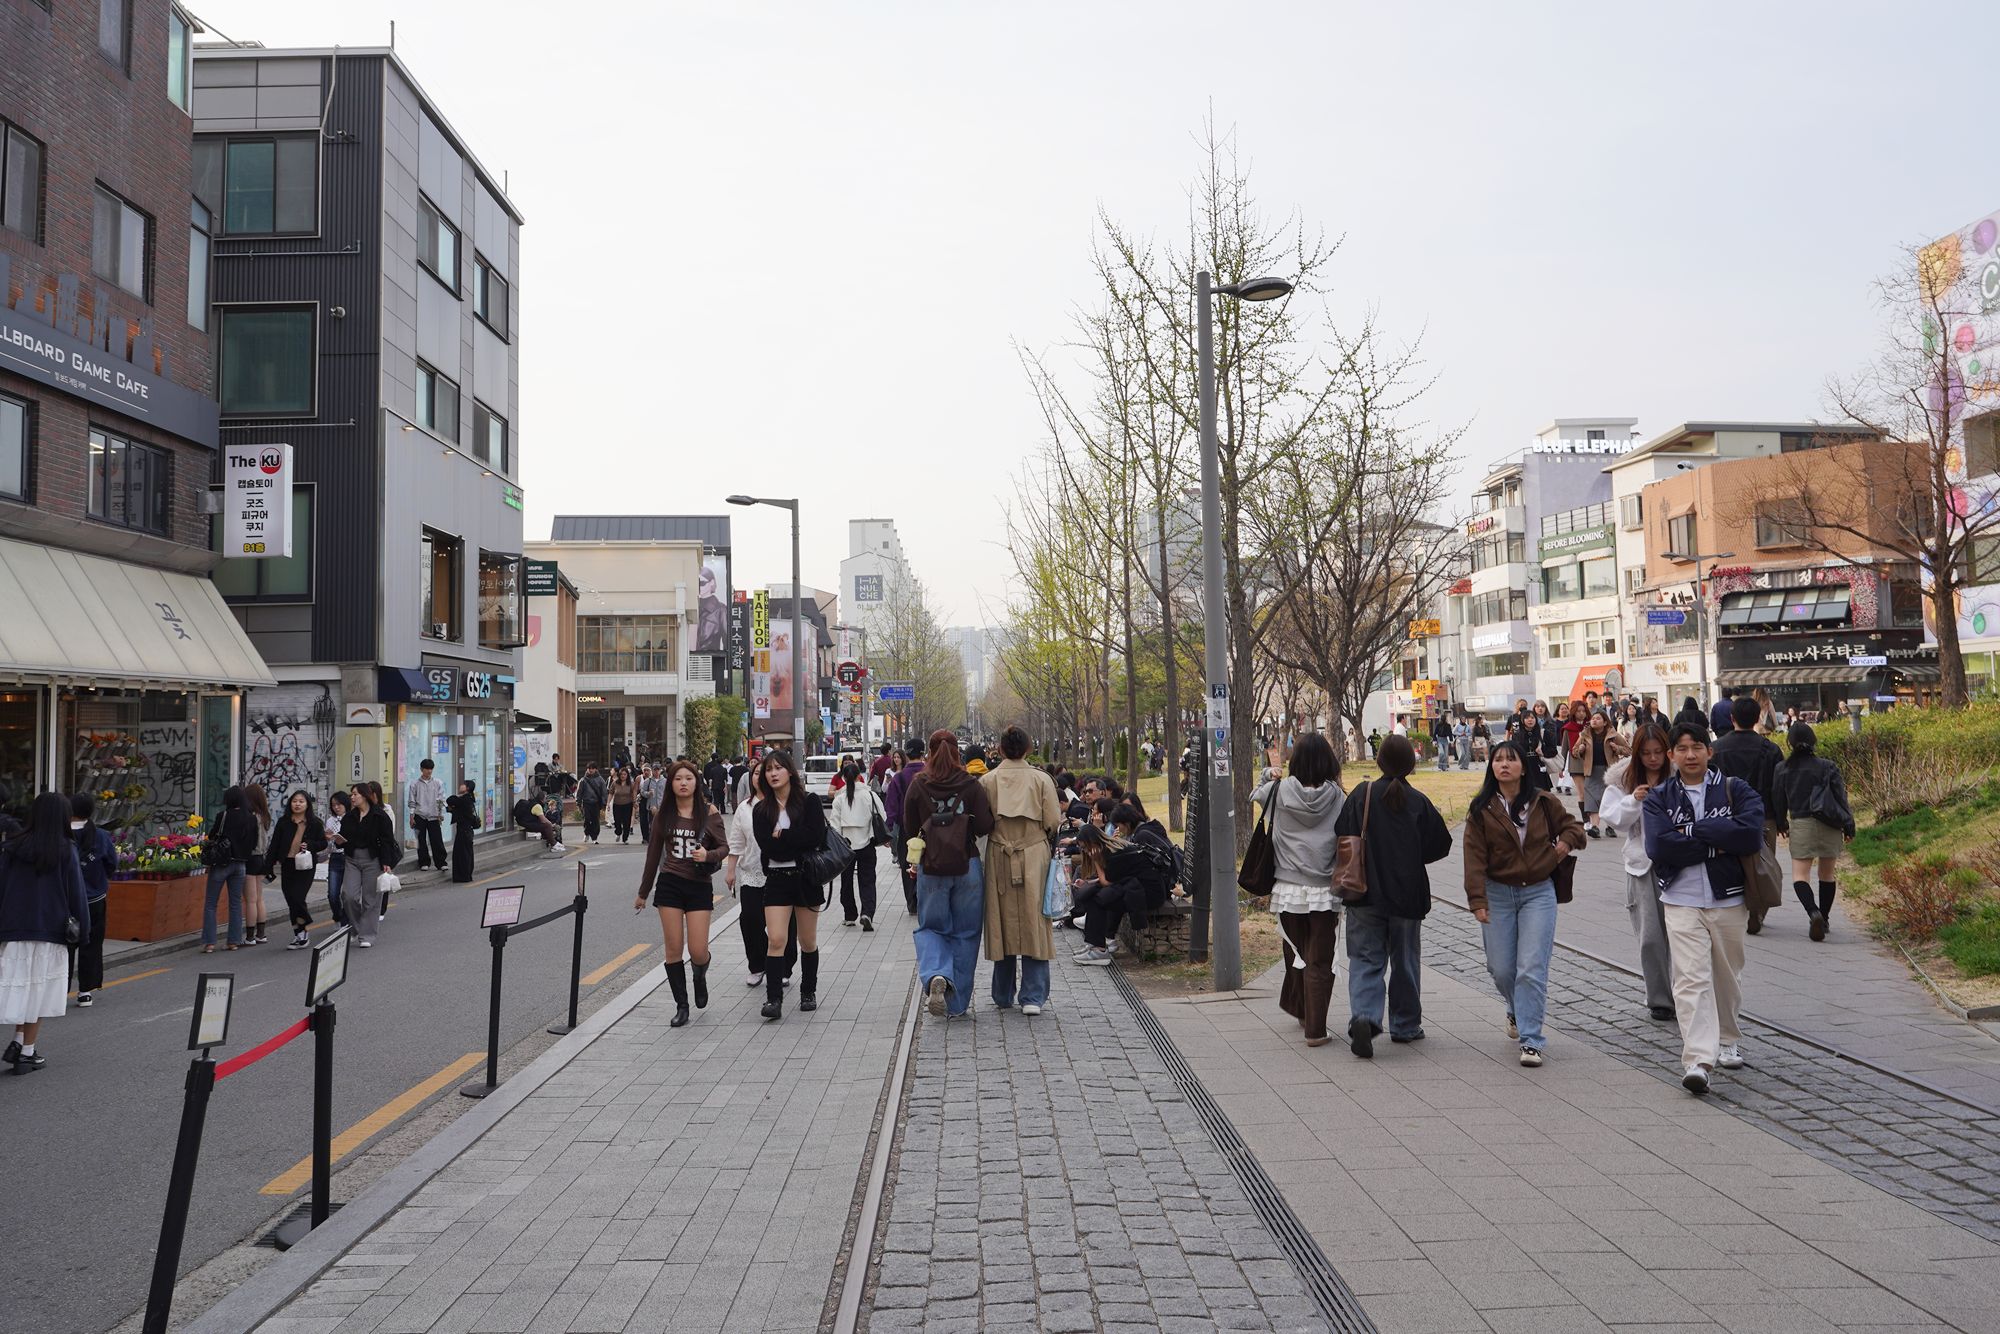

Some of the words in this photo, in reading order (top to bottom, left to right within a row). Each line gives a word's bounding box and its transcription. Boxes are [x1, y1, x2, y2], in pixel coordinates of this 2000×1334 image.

[0, 325, 65, 364] LBOARD
[72, 353, 111, 383] GAME
[116, 371, 149, 399] CAFE
[1533, 439, 1572, 454] BLUE
[229, 455, 257, 468] The
[261, 454, 280, 467] KU
[238, 479, 273, 489] 캡슐토이
[246, 499, 264, 509] 굿즈
[241, 511, 269, 520] 피규어
[246, 522, 264, 532] 쿠지
[1543, 539, 1568, 551] BEFORE
[1568, 529, 1604, 546] BLOOMING
[508, 563, 516, 616] CAFE
[155, 602, 192, 641] 꽃
[755, 593, 763, 645] TATTOO
[1850, 657, 1884, 666] Caricature
[428, 669, 451, 684] GS
[431, 684, 450, 700] 25
[467, 671, 491, 698] GS25
[672, 837, 698, 859] 38
